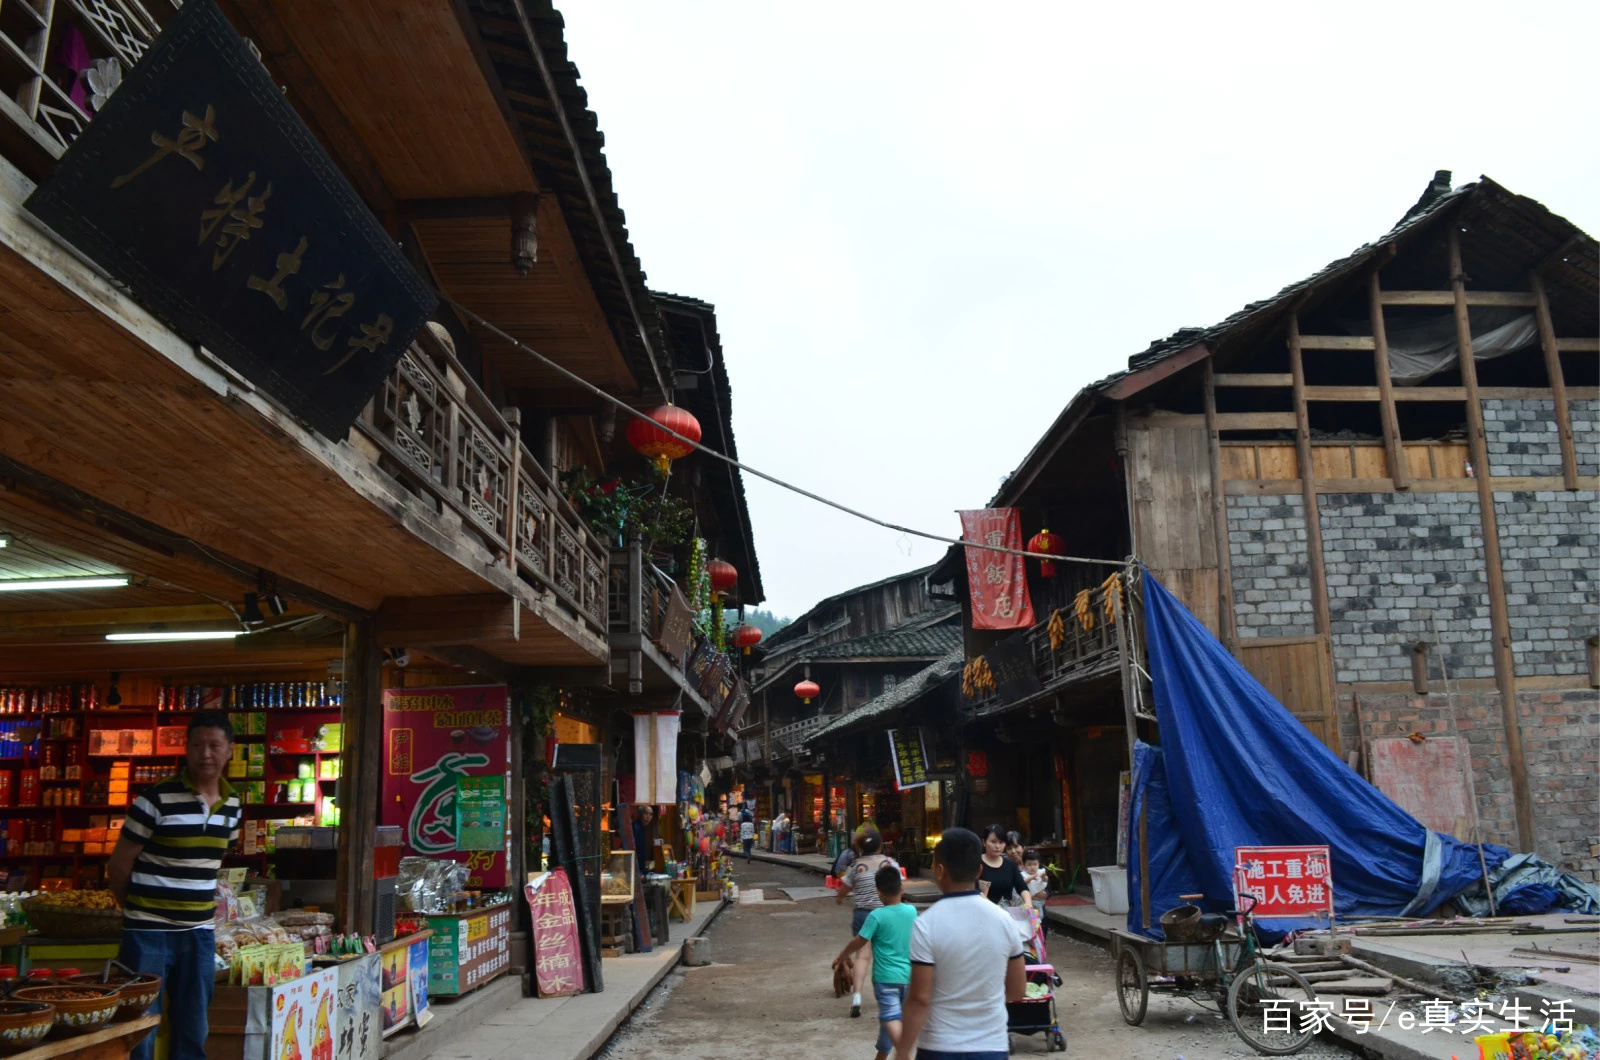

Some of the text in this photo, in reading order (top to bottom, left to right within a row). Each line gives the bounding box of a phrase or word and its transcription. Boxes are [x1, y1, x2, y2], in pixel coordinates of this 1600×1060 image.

[1247, 858, 1324, 879] 施工重地
[1249, 884, 1326, 905] 闲人免进
[558, 889, 575, 926] 成品
